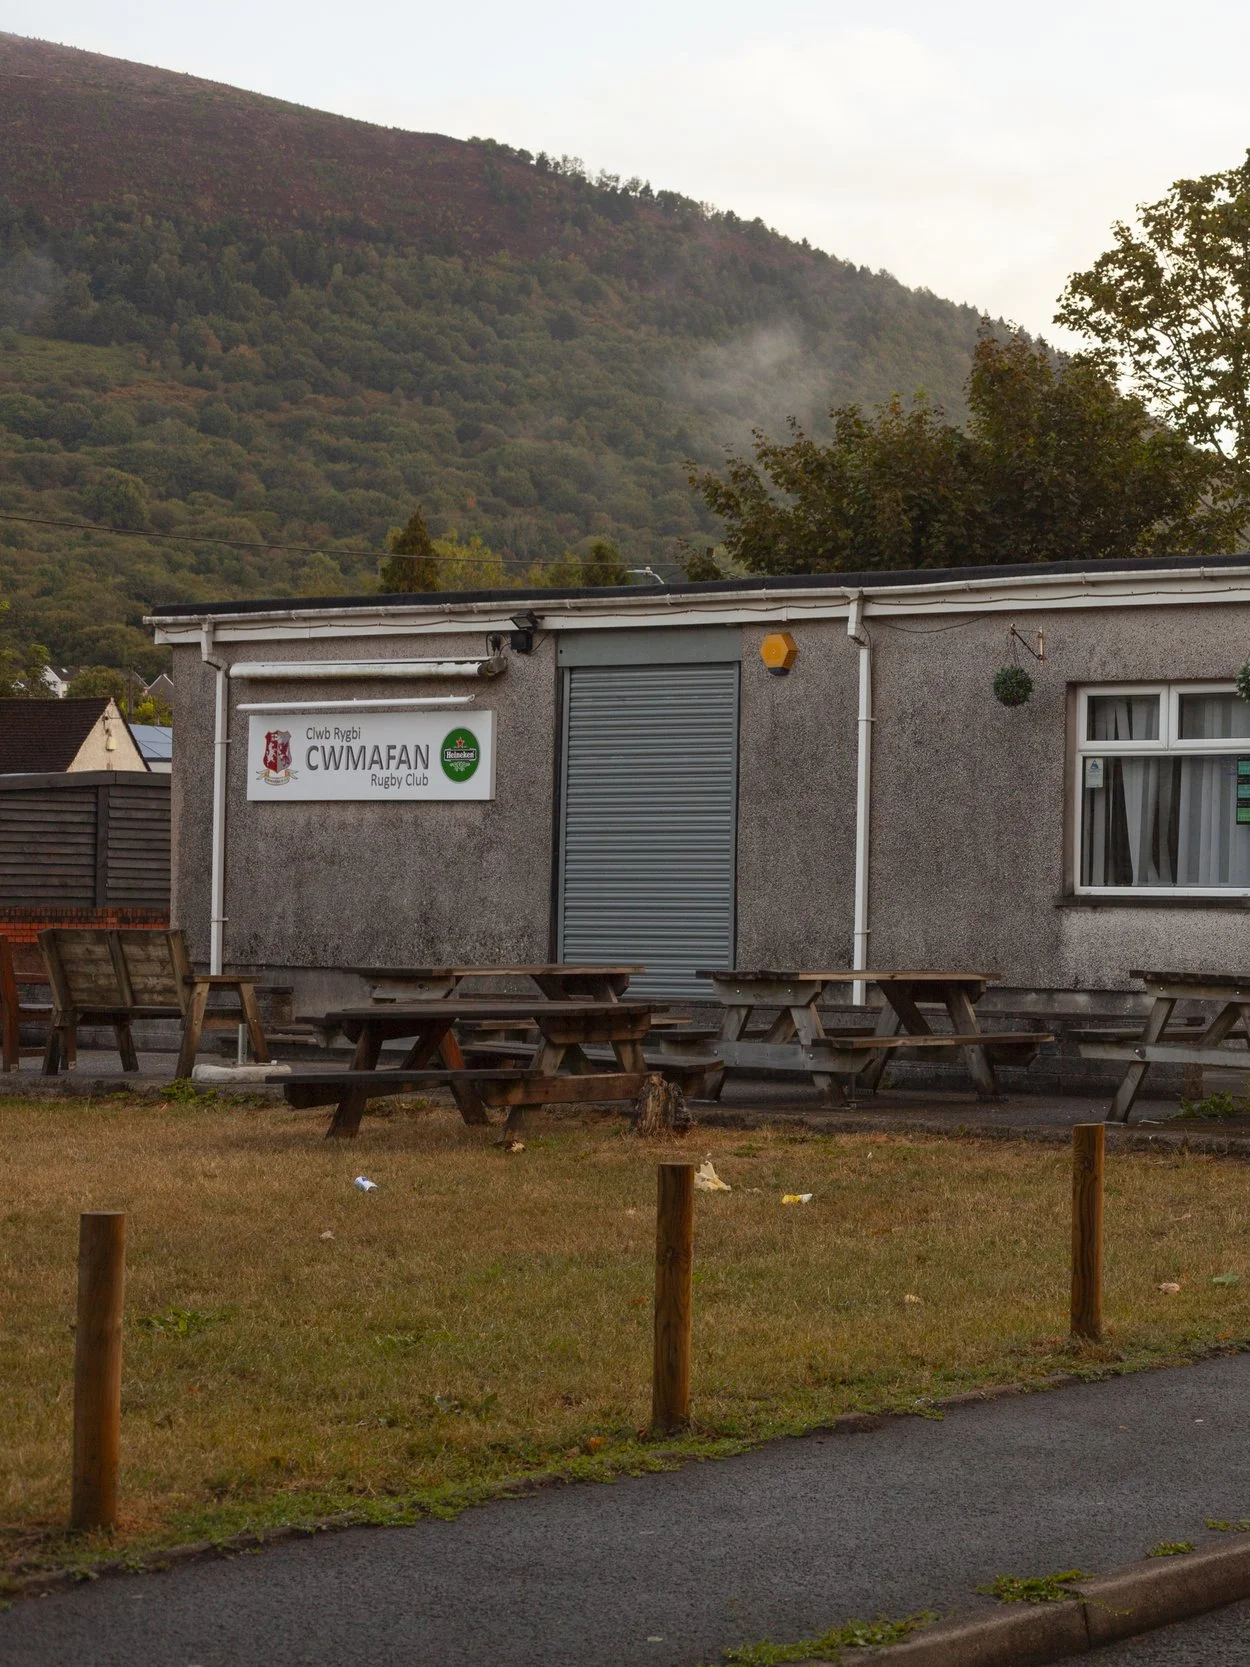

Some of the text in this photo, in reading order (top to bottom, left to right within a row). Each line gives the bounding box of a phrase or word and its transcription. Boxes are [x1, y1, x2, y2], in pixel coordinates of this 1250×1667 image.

[306, 727, 361, 742] Clwb Rygbi
[305, 744, 430, 771] CWMAFAN
[446, 750, 475, 759] Heineken
[371, 773, 429, 789] Rugby Club
